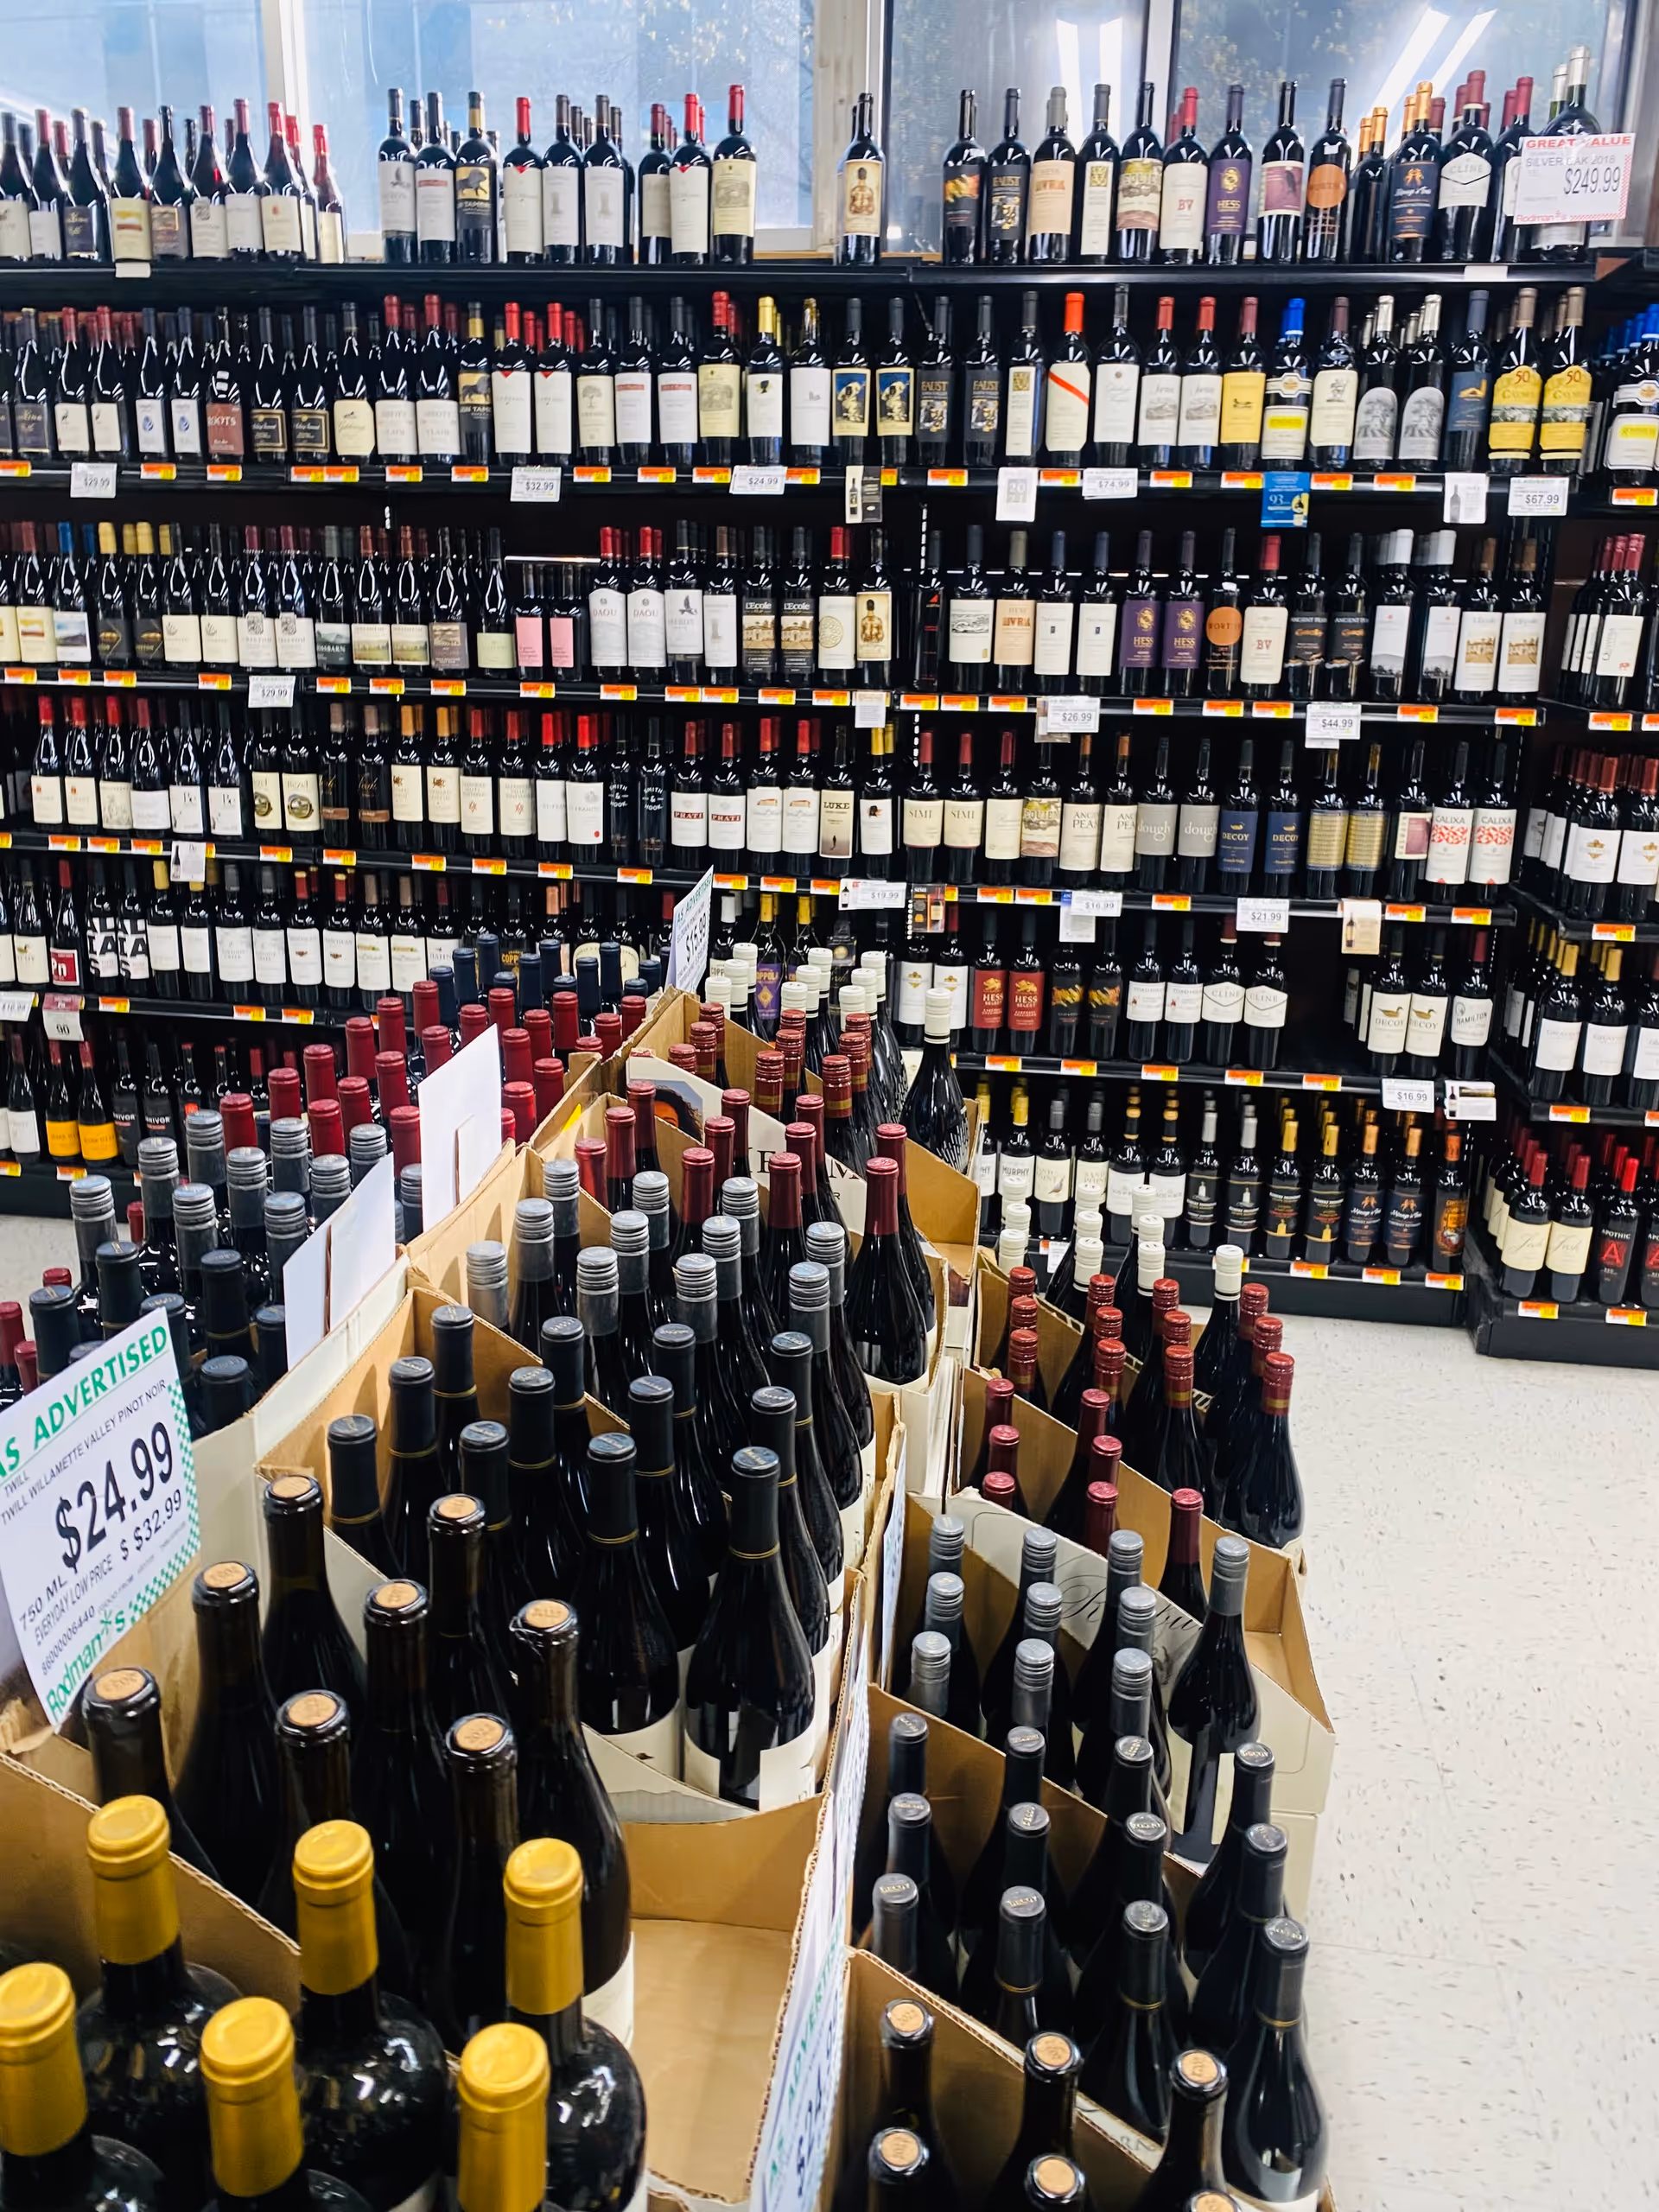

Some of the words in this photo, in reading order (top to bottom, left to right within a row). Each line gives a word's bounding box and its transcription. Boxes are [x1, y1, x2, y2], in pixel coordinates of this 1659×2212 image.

[1526, 138, 1575, 149] GREAT
[1526, 156, 1562, 167] SILVER
[1564, 166, 1621, 194] $249.99
[1178, 199, 1194, 211] BV
[1217, 200, 1241, 210] HESS
[1515, 370, 1530, 384] 50
[1567, 370, 1581, 385] 50
[921, 380, 948, 391] FAUST
[973, 380, 999, 391] FAUST
[525, 480, 554, 492] $32.99
[748, 477, 779, 486] $24.99
[1269, 494, 1283, 506] 93
[1525, 493, 1560, 505] $67.99
[593, 608, 617, 618] DAOU
[633, 608, 658, 618] DAOU
[1133, 636, 1154, 646] HESS
[1173, 637, 1196, 647] HESS
[1255, 639, 1273, 650] BV
[1061, 712, 1092, 722] $26.99
[1321, 718, 1354, 728] $44.99
[823, 801, 850, 810] LUKE
[674, 811, 704, 820] PRATI
[909, 809, 932, 819] SIMI
[950, 810, 975, 820] SIMI
[1435, 814, 1466, 824] CALIXA
[1481, 817, 1513, 825] CALIXA
[1137, 821, 1171, 842] dough
[1222, 832, 1250, 842] DECOY
[1272, 834, 1299, 842] DECOY
[685, 873, 713, 914] ADVERTISED
[871, 891, 899, 899] $19.99
[1251, 912, 1281, 921] $21.99
[685, 912, 707, 963] $15.99
[51, 957, 67, 977] Pn
[982, 993, 1003, 1001] HESS
[1014, 995, 1038, 1003] HESS
[1211, 988, 1241, 999] CLINE
[1249, 992, 1279, 1003] CLINE
[1375, 1017, 1405, 1027] DECOY
[1409, 1019, 1439, 1030] DECOY
[56, 1024, 70, 1036] 90
[1397, 1090, 1428, 1103] $16.99
[1001, 1166, 1030, 1176] MURPHY
[1601, 1228, 1631, 1240] APOTHIC
[1600, 1242, 1622, 1265] A
[33, 1325, 168, 1451] ADVERTISED
[0, 1495, 29, 1526] TWILL
[29, 1447, 84, 1500] WILLAMETTE
[85, 1417, 117, 1450] VALLEY
[118, 1394, 144, 1424] PINOT
[146, 1378, 168, 1402] NOIR
[4, 1471, 31, 1498] TWILL
[55, 1421, 173, 1575] $24.99
[35, 1599, 72, 1647] EVERYDAY
[71, 1582, 89, 1612] LOW
[88, 1554, 114, 1591] PRICE
[119, 1538, 130, 1561] $
[133, 1489, 182, 1552] $32.99
[19, 1597, 43, 1632] 750
[45, 1573, 69, 1602] ML
